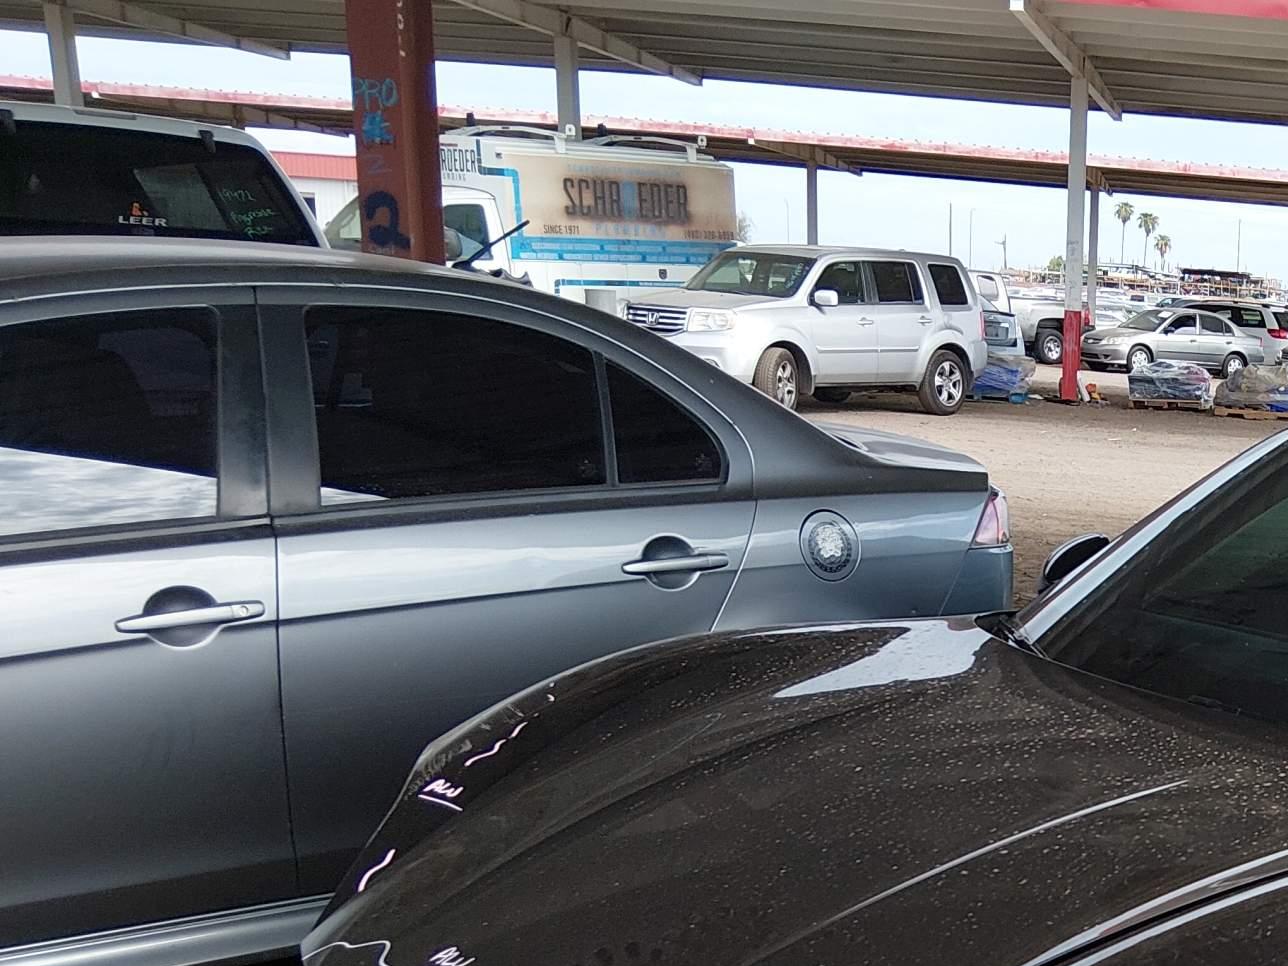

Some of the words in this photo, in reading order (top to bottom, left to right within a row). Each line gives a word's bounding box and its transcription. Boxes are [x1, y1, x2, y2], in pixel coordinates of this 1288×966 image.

[441, 149, 477, 173] ROEDER
[118, 216, 168, 227] LEER
[364, 190, 411, 249] 2
[543, 224, 563, 234] SINCE
[565, 225, 580, 235] 1971
